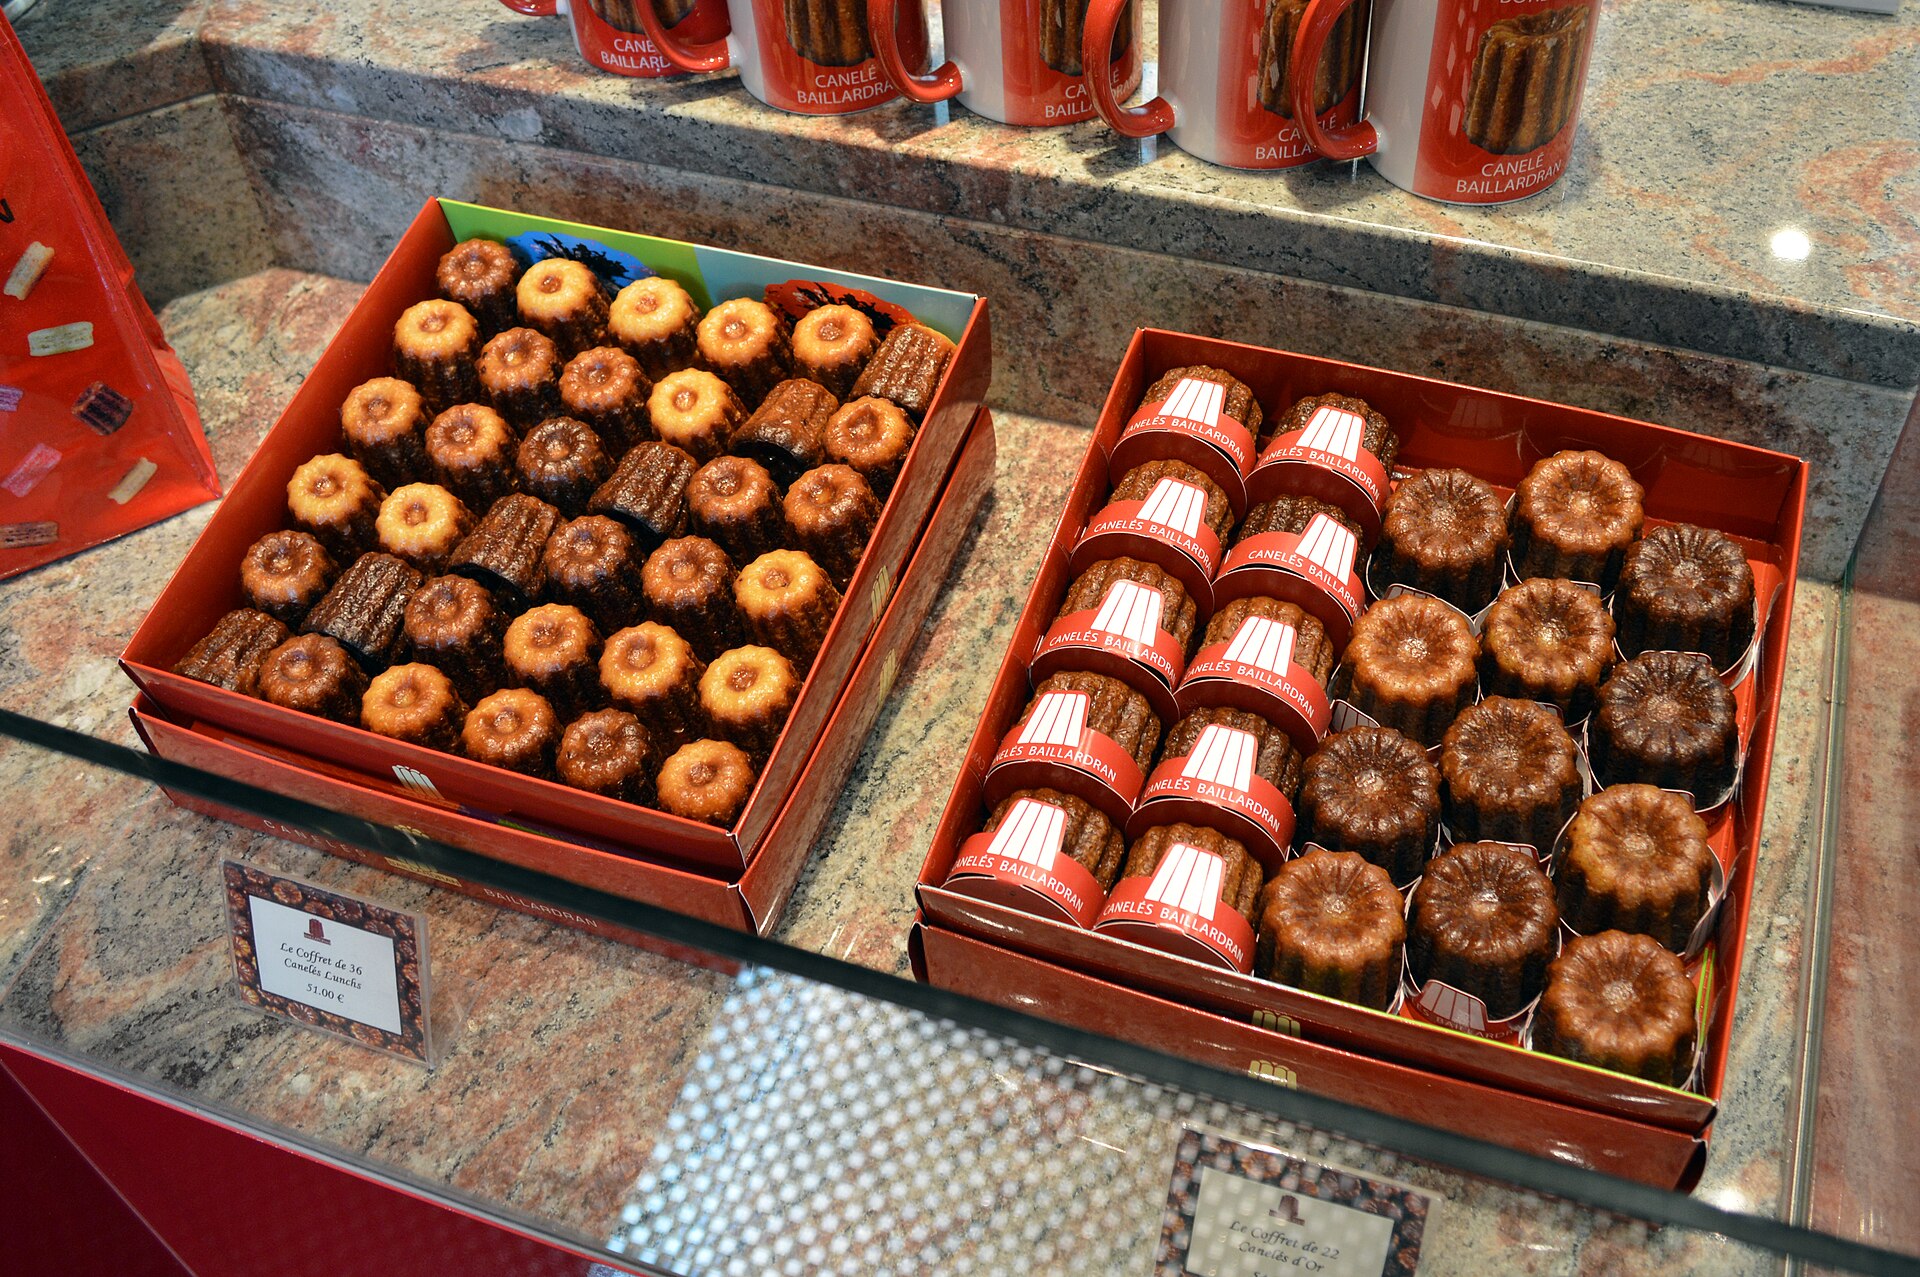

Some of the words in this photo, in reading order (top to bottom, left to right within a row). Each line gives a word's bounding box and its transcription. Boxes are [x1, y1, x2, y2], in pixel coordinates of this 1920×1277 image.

[614, 38, 657, 53] CANE
[797, 80, 894, 104] BAILLARDRA
[815, 64, 877, 88] CANELÉ
[1456, 160, 1562, 194] BAILLARDRAN
[1481, 152, 1545, 177] CANELÉ
[1171, 418, 1245, 463] BAILLARDRAN
[1308, 450, 1380, 500] BAILLARDRAN
[1093, 519, 1144, 533] CANELÉS
[1248, 549, 1304, 568] CANELÉS
[1049, 630, 1099, 647] CANELÉS
[1236, 665, 1315, 719] BAILLARDRAN
[1028, 745, 1117, 782] BAILLARDRAN
[1196, 783, 1281, 833] BAILLARDRAN
[999, 860, 1084, 913] BAILLARDRAN
[483, 888, 598, 928] BAILLARDRAN
[1103, 901, 1154, 916] CANELÉS
[1159, 907, 1244, 963] BAILLARDRAN
[280, 942, 294, 954] Le
[296, 947, 332, 964] Coffret
[334, 959, 347, 970] de
[349, 964, 363, 976] 36
[284, 958, 322, 977] Canelés
[324, 971, 362, 990] Lunchs
[306, 983, 335, 1000] 51.00
[337, 993, 345, 1004] €
[1229, 1220, 1248, 1233] Le
[1250, 1227, 1299, 1248] Coffret
[1301, 1241, 1319, 1254] de
[1321, 1246, 1340, 1260] 22
[1238, 1241, 1290, 1263] Canelés
